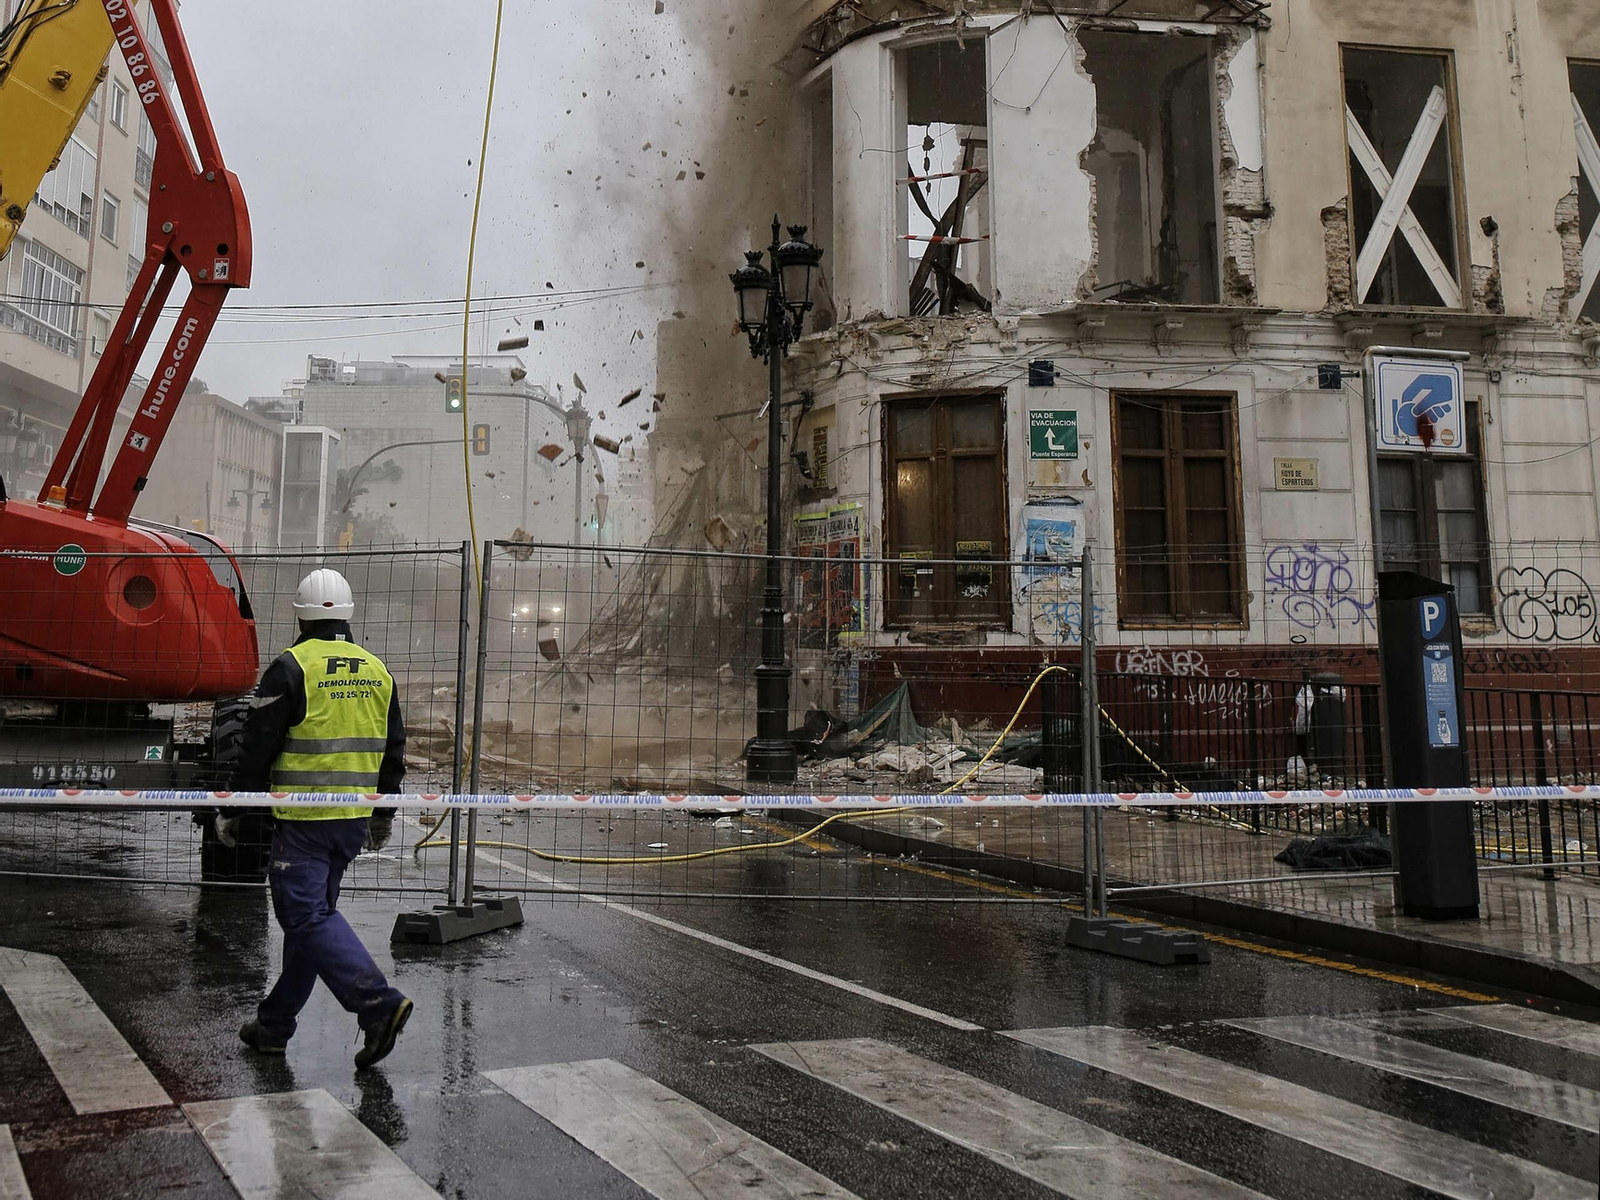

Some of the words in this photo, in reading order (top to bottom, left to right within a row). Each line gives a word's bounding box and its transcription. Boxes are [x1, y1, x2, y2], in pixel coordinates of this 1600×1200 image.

[117, 25, 138, 49] 10
[127, 52, 149, 77] 86
[138, 79, 160, 104] 86
[141, 317, 199, 420] hune.com
[1423, 601, 1440, 632] P
[322, 656, 368, 675] FT
[318, 679, 383, 689] DEMOLICIONES
[330, 691, 345, 700] 952
